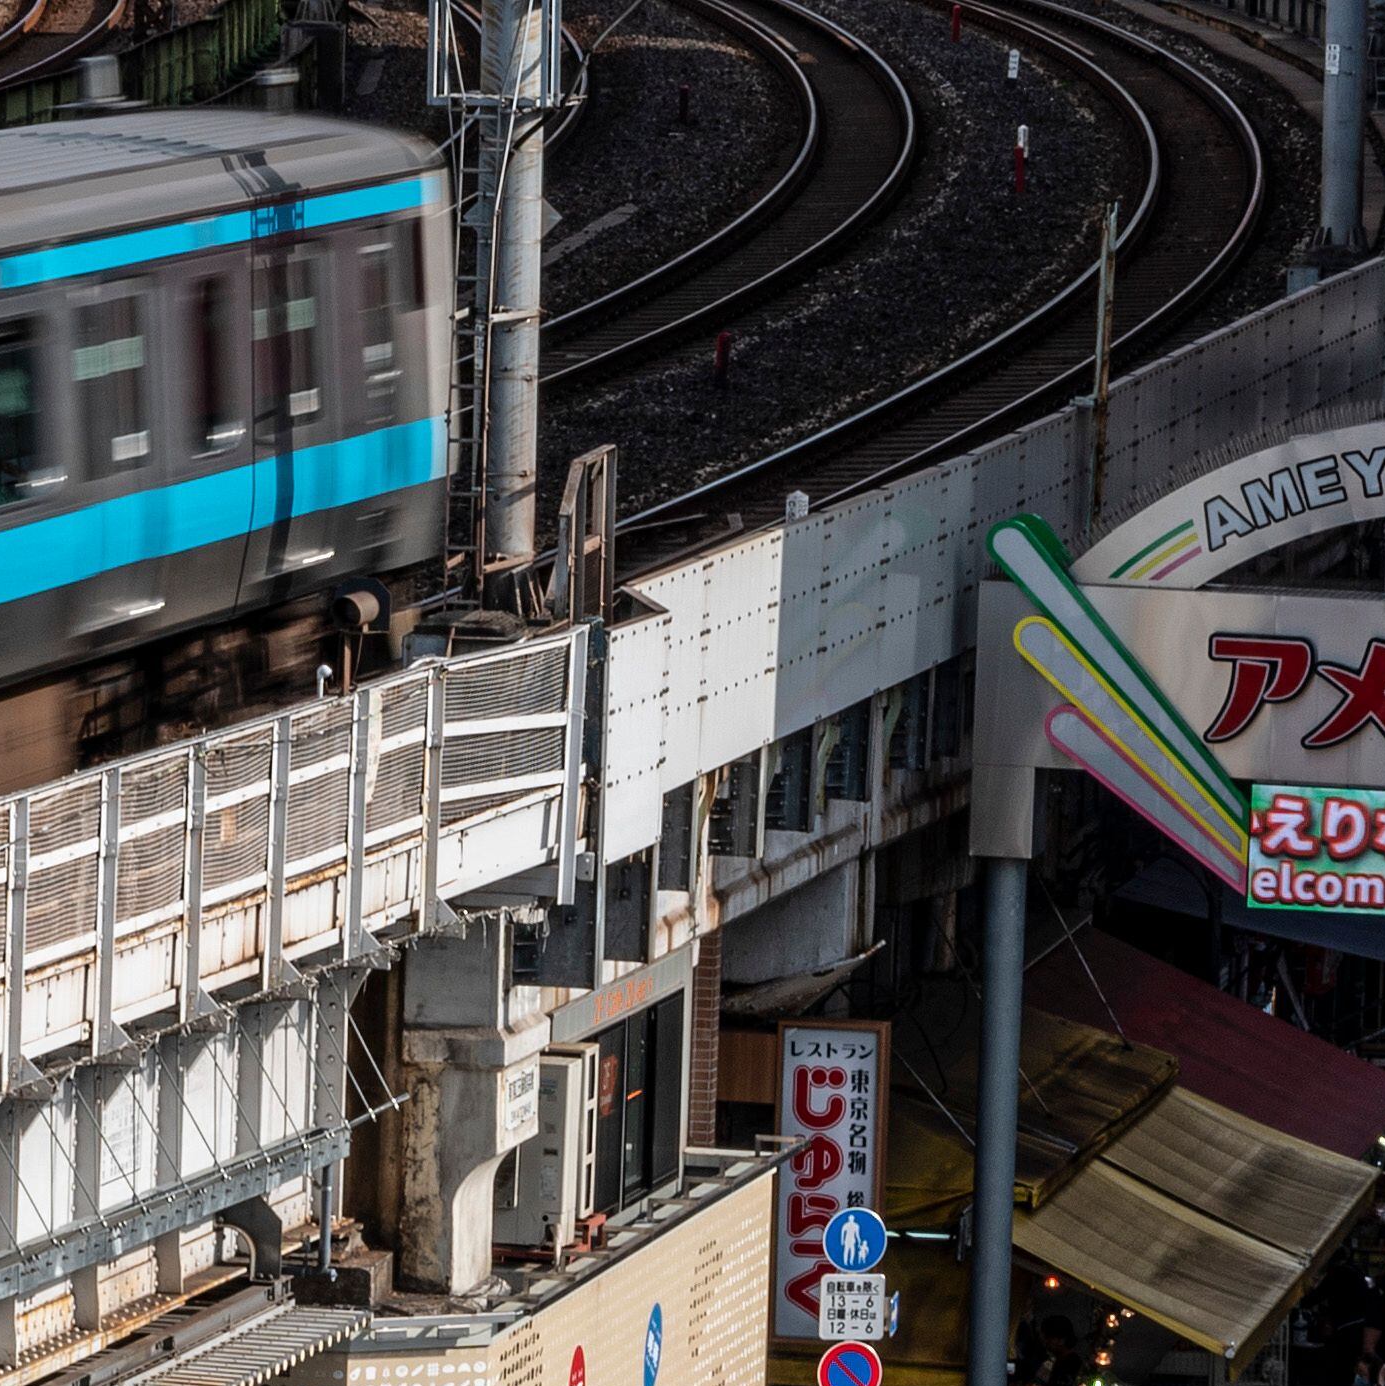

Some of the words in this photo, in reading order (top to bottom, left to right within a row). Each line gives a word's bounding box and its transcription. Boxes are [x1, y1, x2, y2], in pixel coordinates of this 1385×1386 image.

[790, 1040, 876, 1060] レストラン
[847, 1069, 870, 1176] 東京名物
[785, 1064, 848, 1322] じゅらく
[826, 1280, 880, 1294] 自転車を除く
[830, 1295, 846, 1308] 13
[830, 1321, 846, 1334] 12
